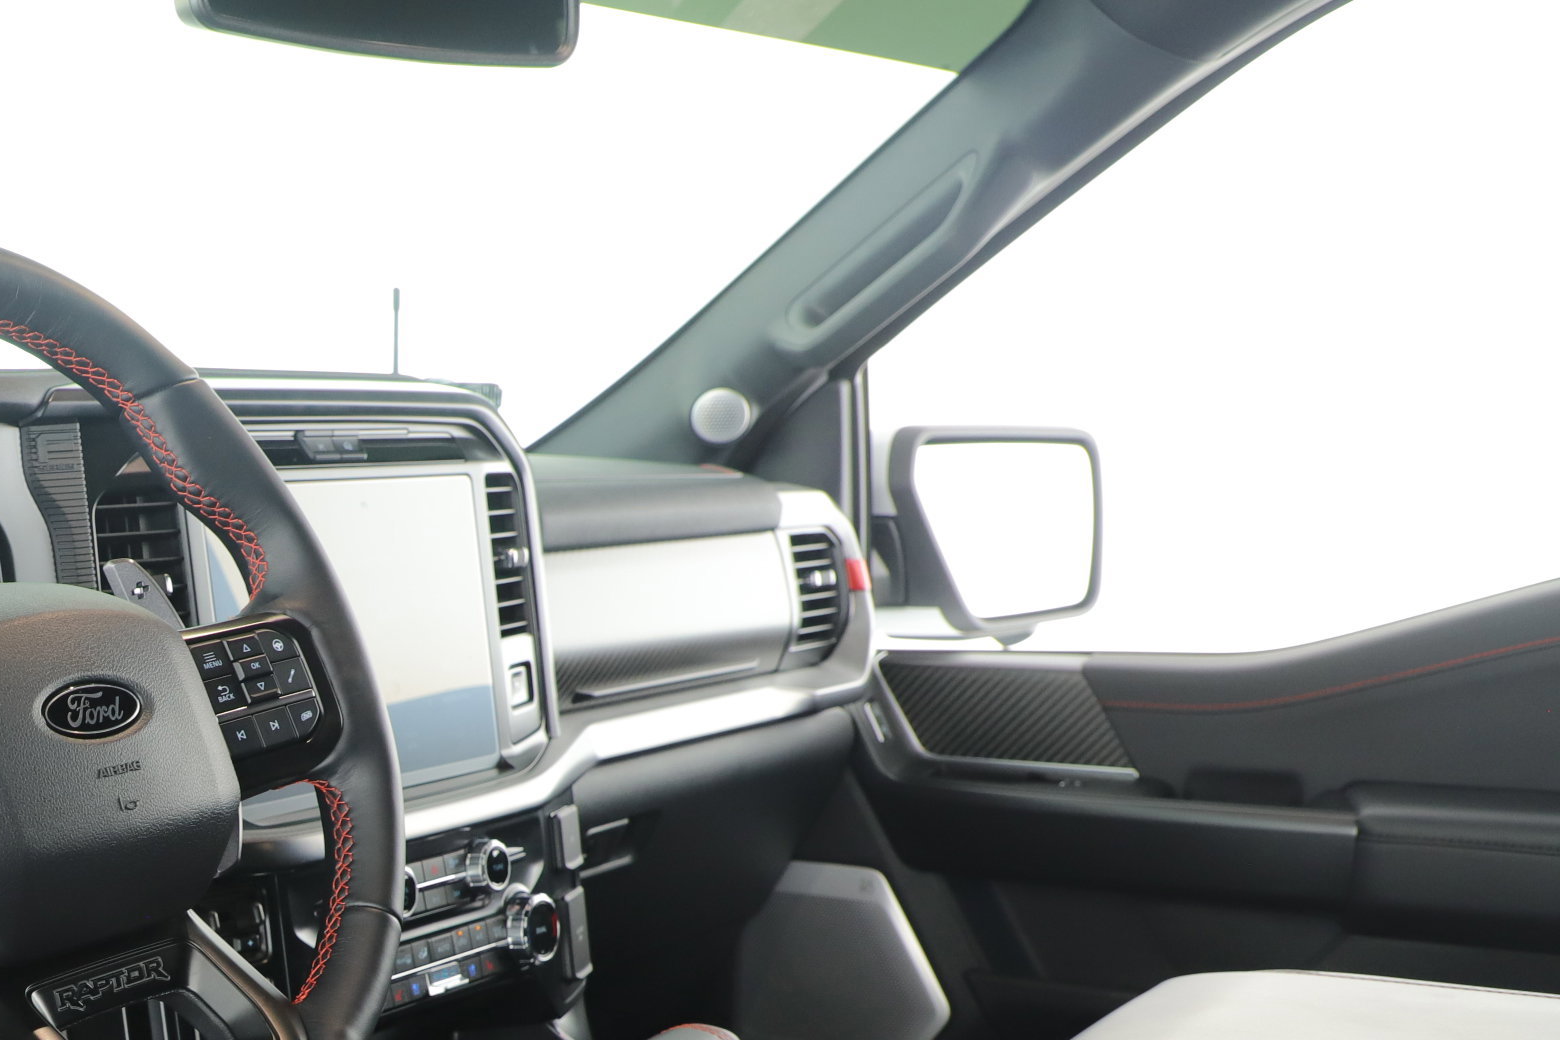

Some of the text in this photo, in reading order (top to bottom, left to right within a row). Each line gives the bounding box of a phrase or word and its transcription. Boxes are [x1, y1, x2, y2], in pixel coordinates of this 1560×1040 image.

[203, 659, 223, 670] MENU
[250, 662, 262, 670] OK
[217, 693, 236, 703] BACK
[67, 690, 124, 728] Ford
[96, 760, 142, 779] AIRBAG
[52, 956, 171, 1012] RAPTOR
